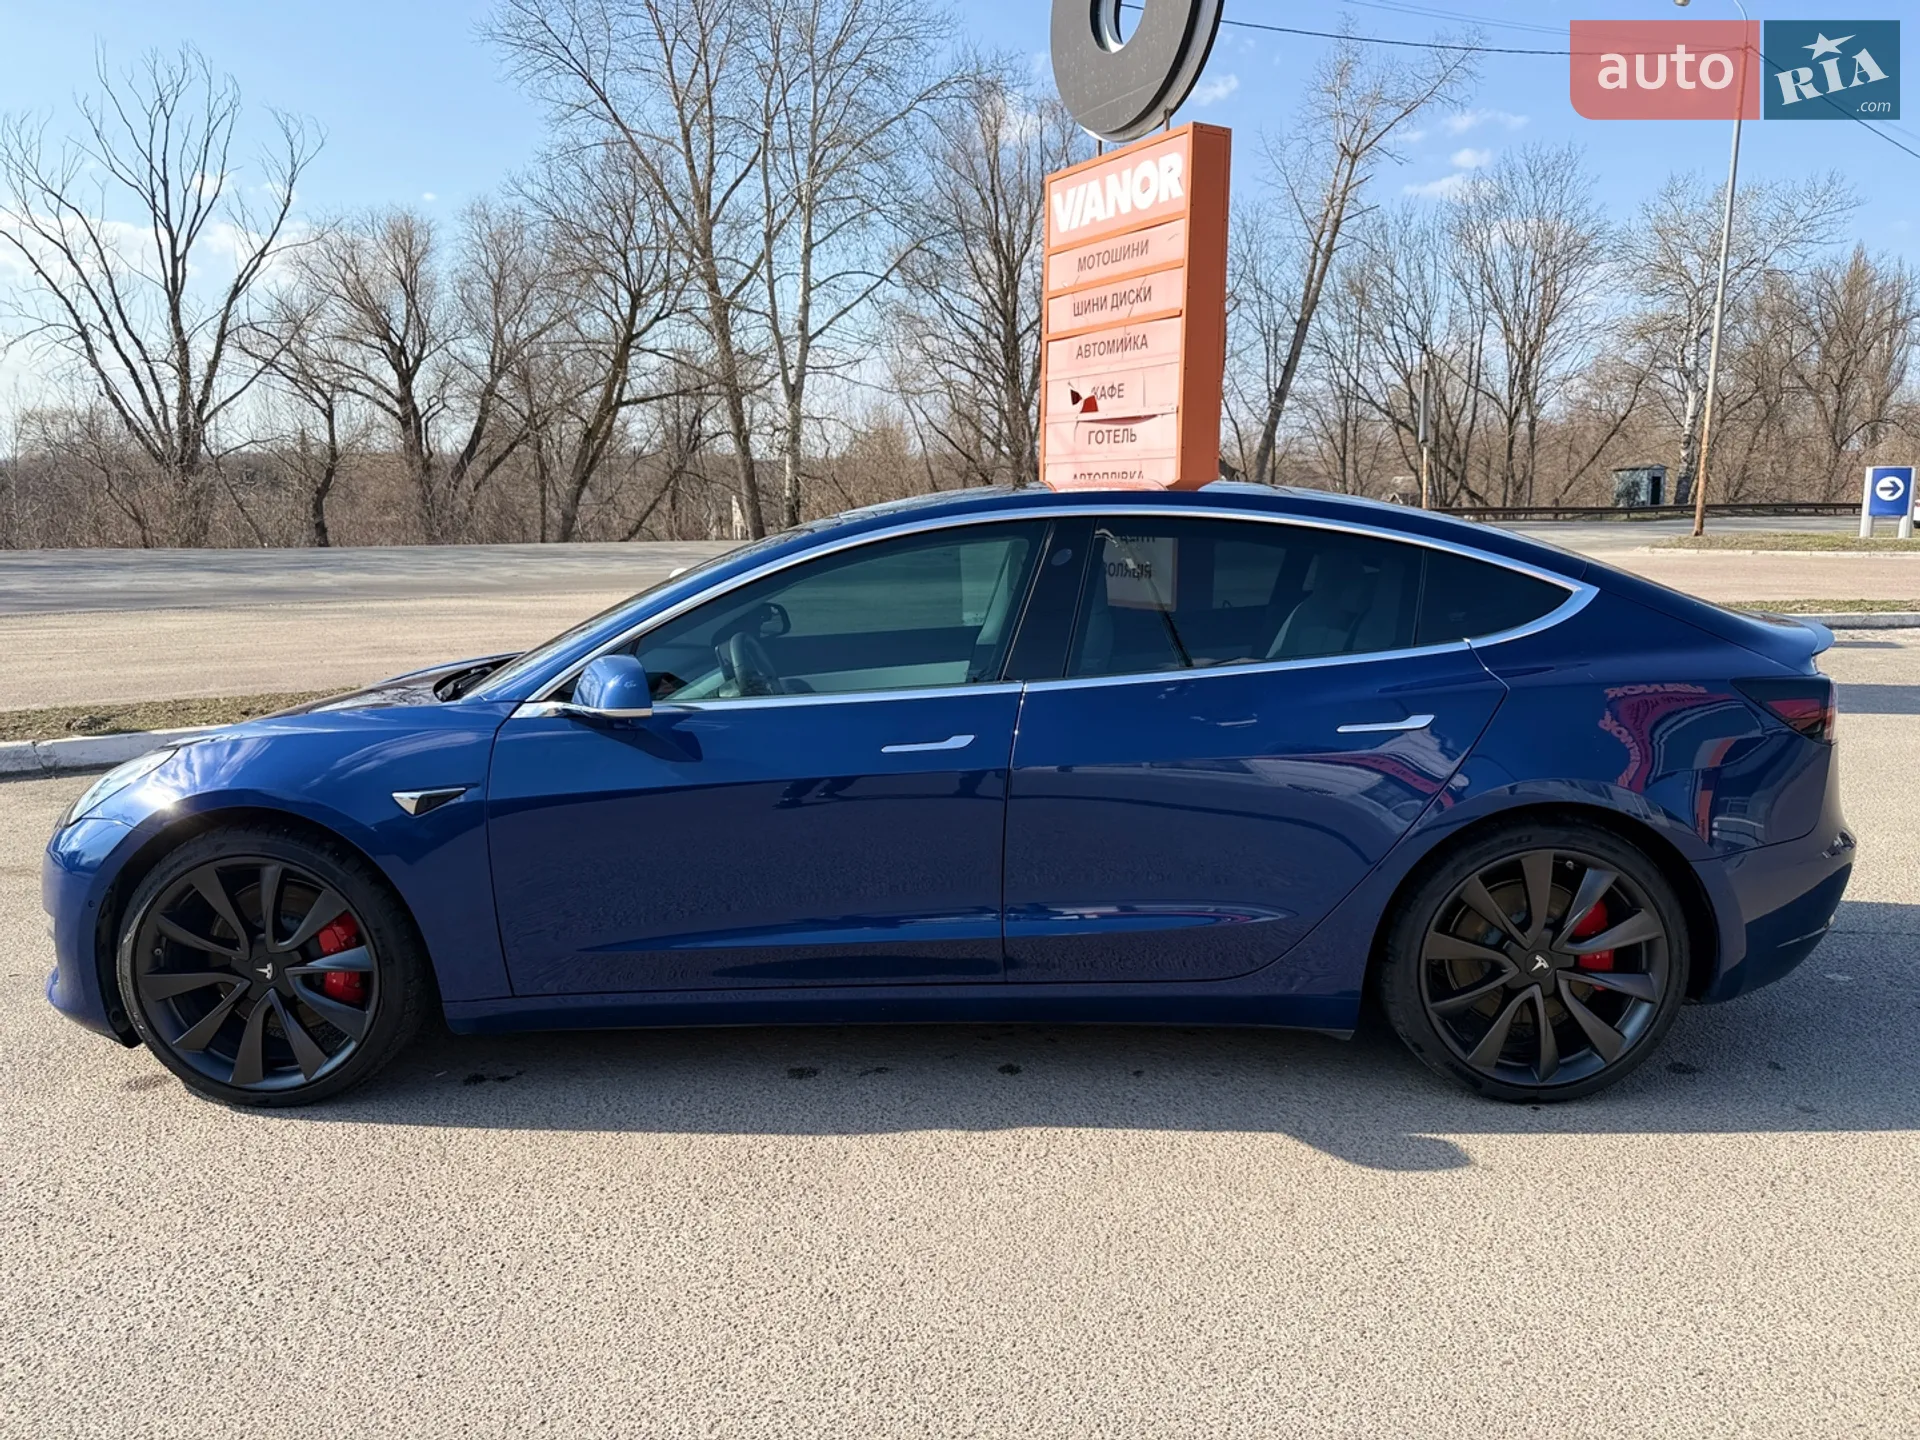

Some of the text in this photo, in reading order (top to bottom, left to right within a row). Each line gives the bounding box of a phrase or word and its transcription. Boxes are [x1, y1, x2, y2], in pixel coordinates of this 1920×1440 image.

[1052, 152, 1184, 233] VIANOR
[1077, 239, 1149, 273] МОТОШИНИ
[1073, 285, 1152, 317] ШИНИ ДИСКИ
[1076, 332, 1149, 360] АВТОМИЙКА
[1091, 382, 1125, 401] КАФЕ
[1087, 428, 1137, 445] ГОТЕЛЬ
[1104, 562, 1152, 581] ОЛЯЦІЯ
